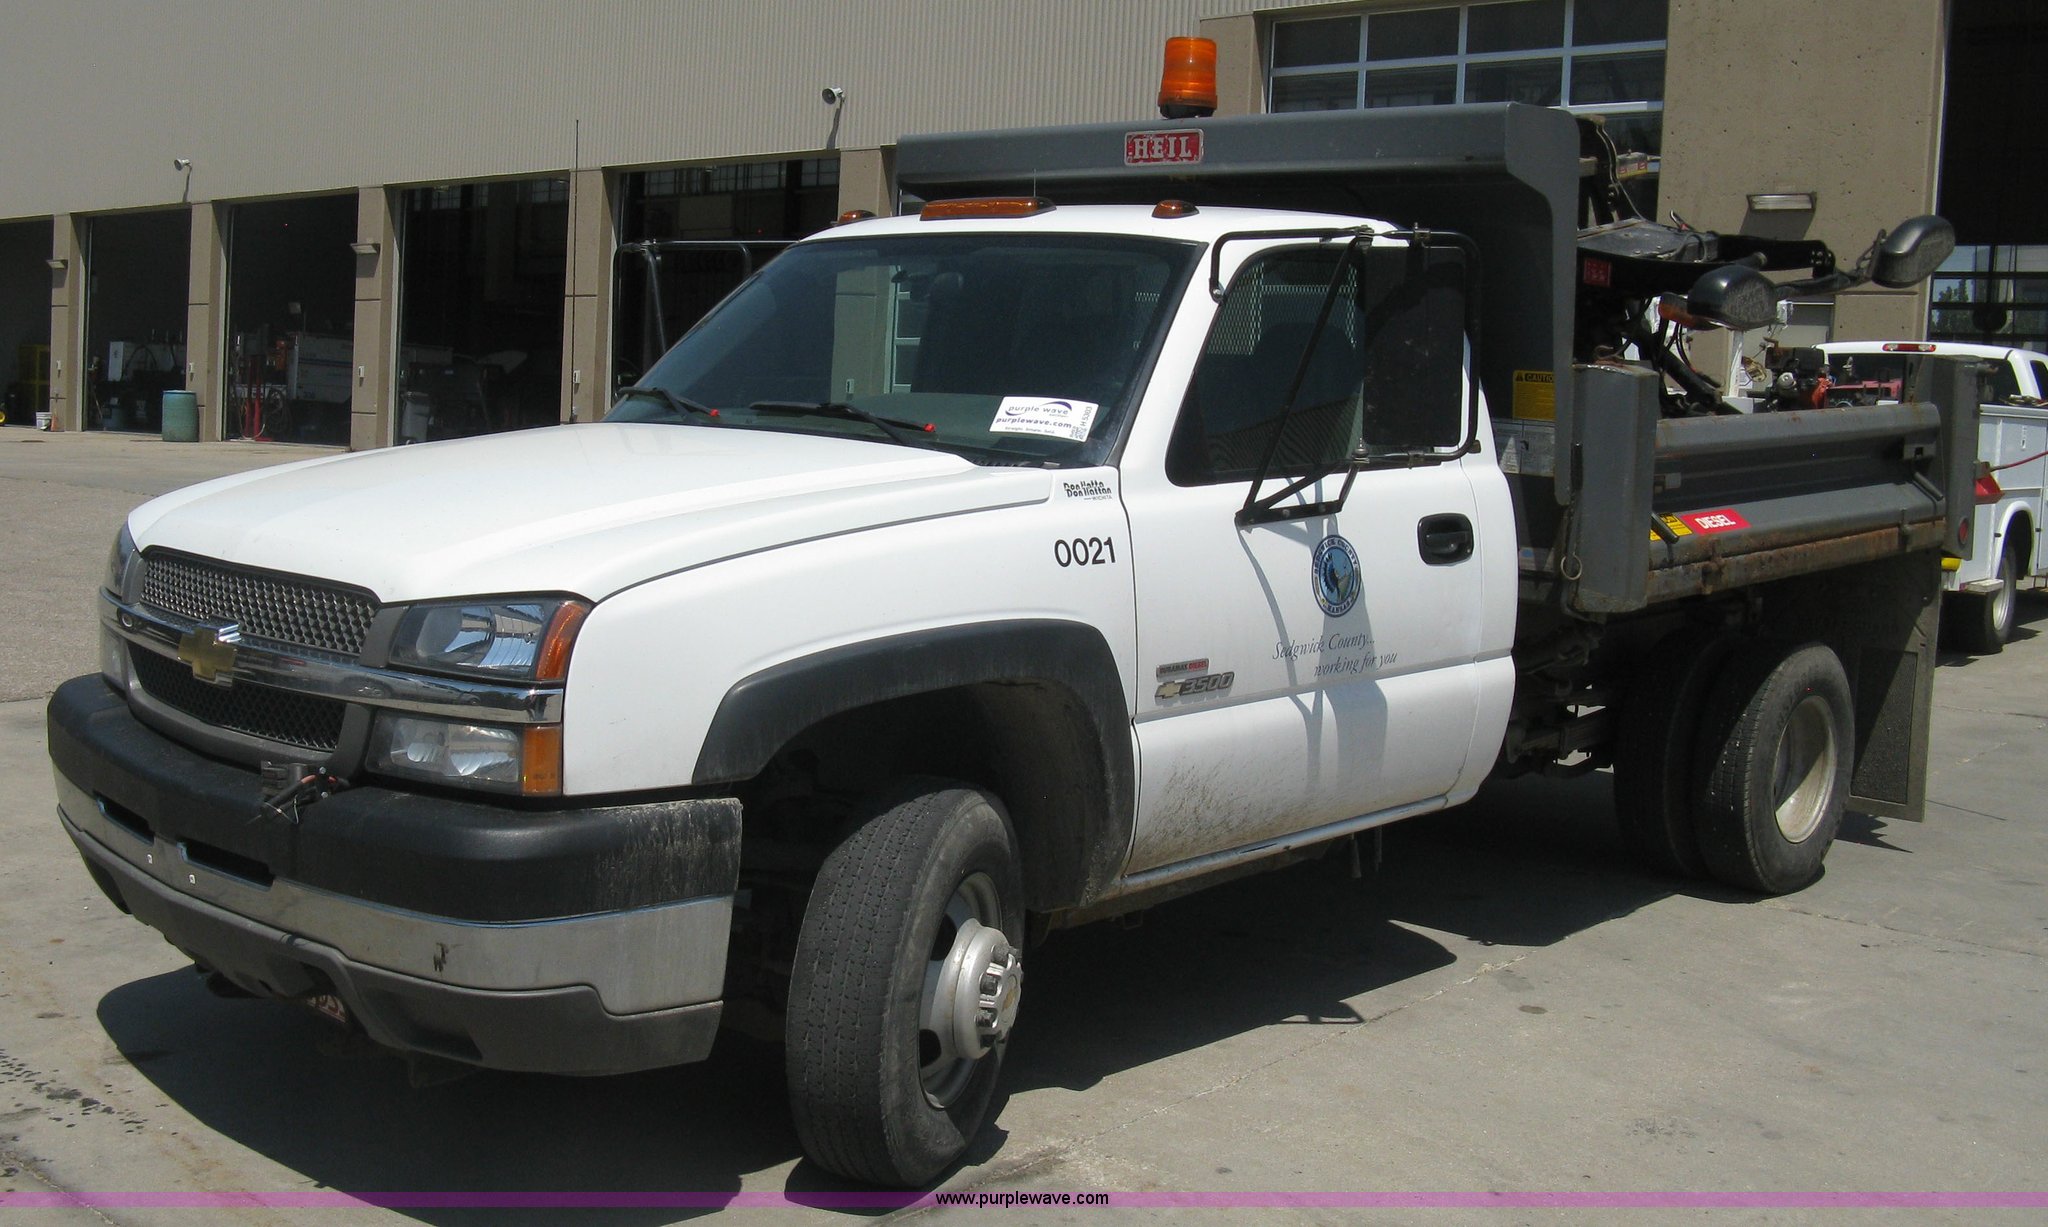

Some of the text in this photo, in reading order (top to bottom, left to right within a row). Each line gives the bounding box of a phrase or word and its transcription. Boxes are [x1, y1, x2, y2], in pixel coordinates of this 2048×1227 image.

[1133, 136, 1192, 159] HEIL
[1526, 373, 1554, 383] CAUTIO
[1008, 405, 1069, 415] purple wave
[995, 416, 1072, 429] purplewave.com
[1066, 488, 1083, 498] Don
[1694, 514, 1736, 529] DIESEL
[1054, 536, 1116, 567] 0021
[1272, 632, 1375, 661] Sedgwick County...
[1313, 651, 1398, 677] working for you
[1180, 672, 1235, 695] 3500
